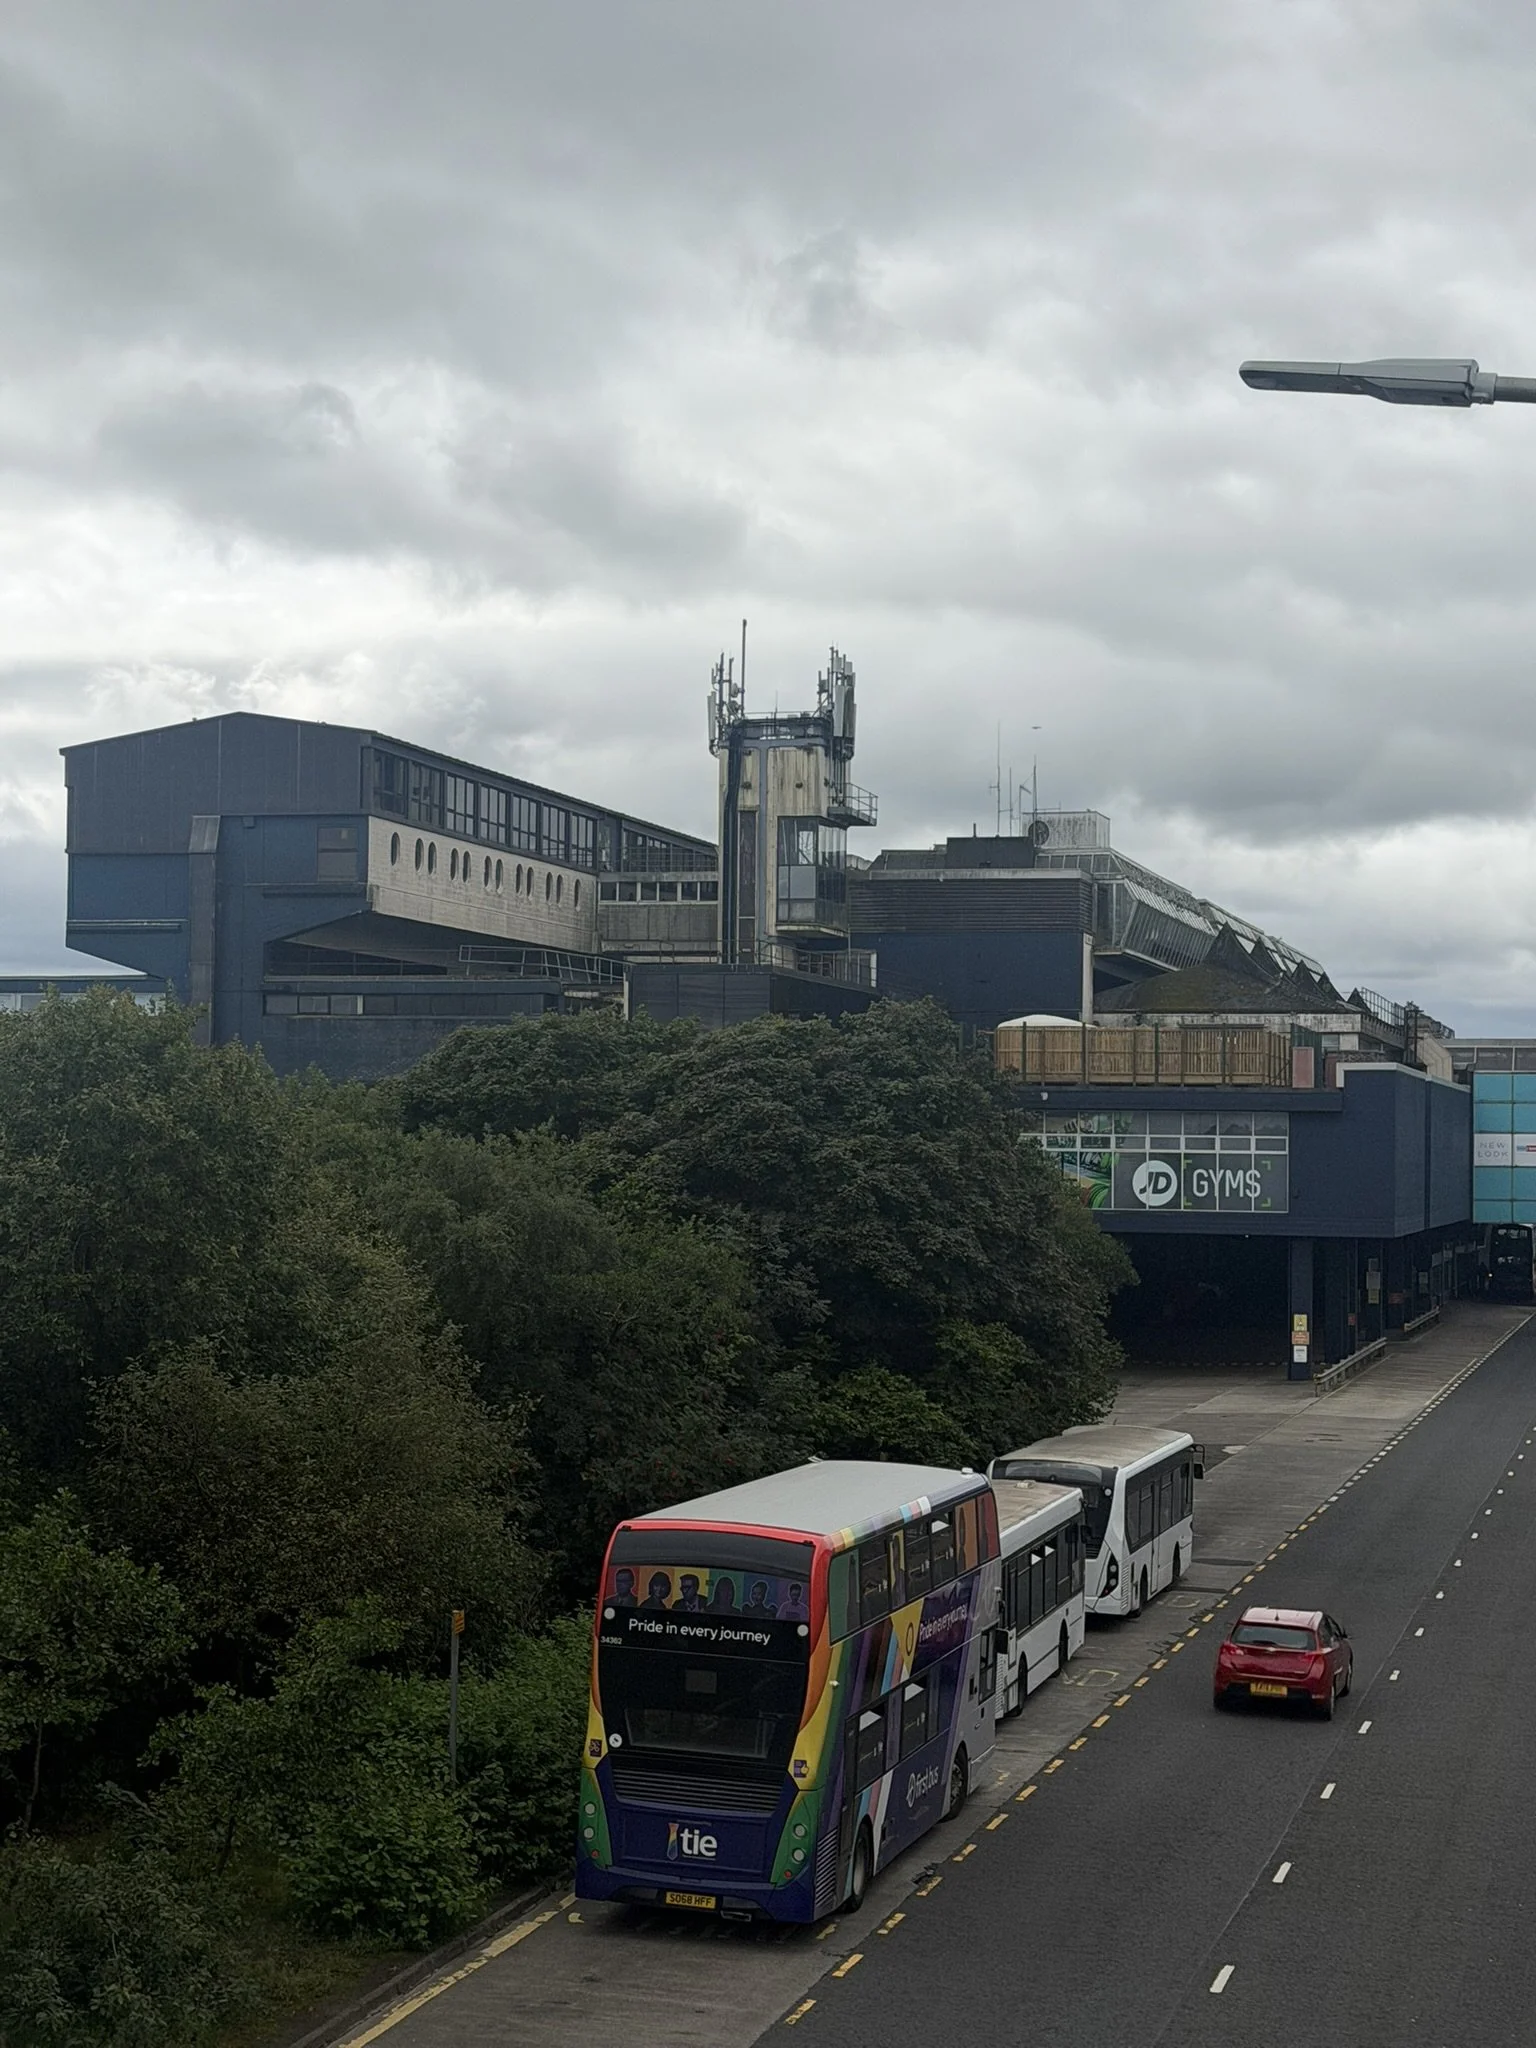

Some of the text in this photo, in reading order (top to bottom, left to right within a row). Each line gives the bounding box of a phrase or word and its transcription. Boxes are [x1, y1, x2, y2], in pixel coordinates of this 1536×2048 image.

[1139, 1169, 1261, 1198] JD GYMS
[628, 1618, 771, 1646] Pride in every journey
[680, 1828, 718, 1857] tie
[669, 1893, 713, 1907] SO68 HFF
